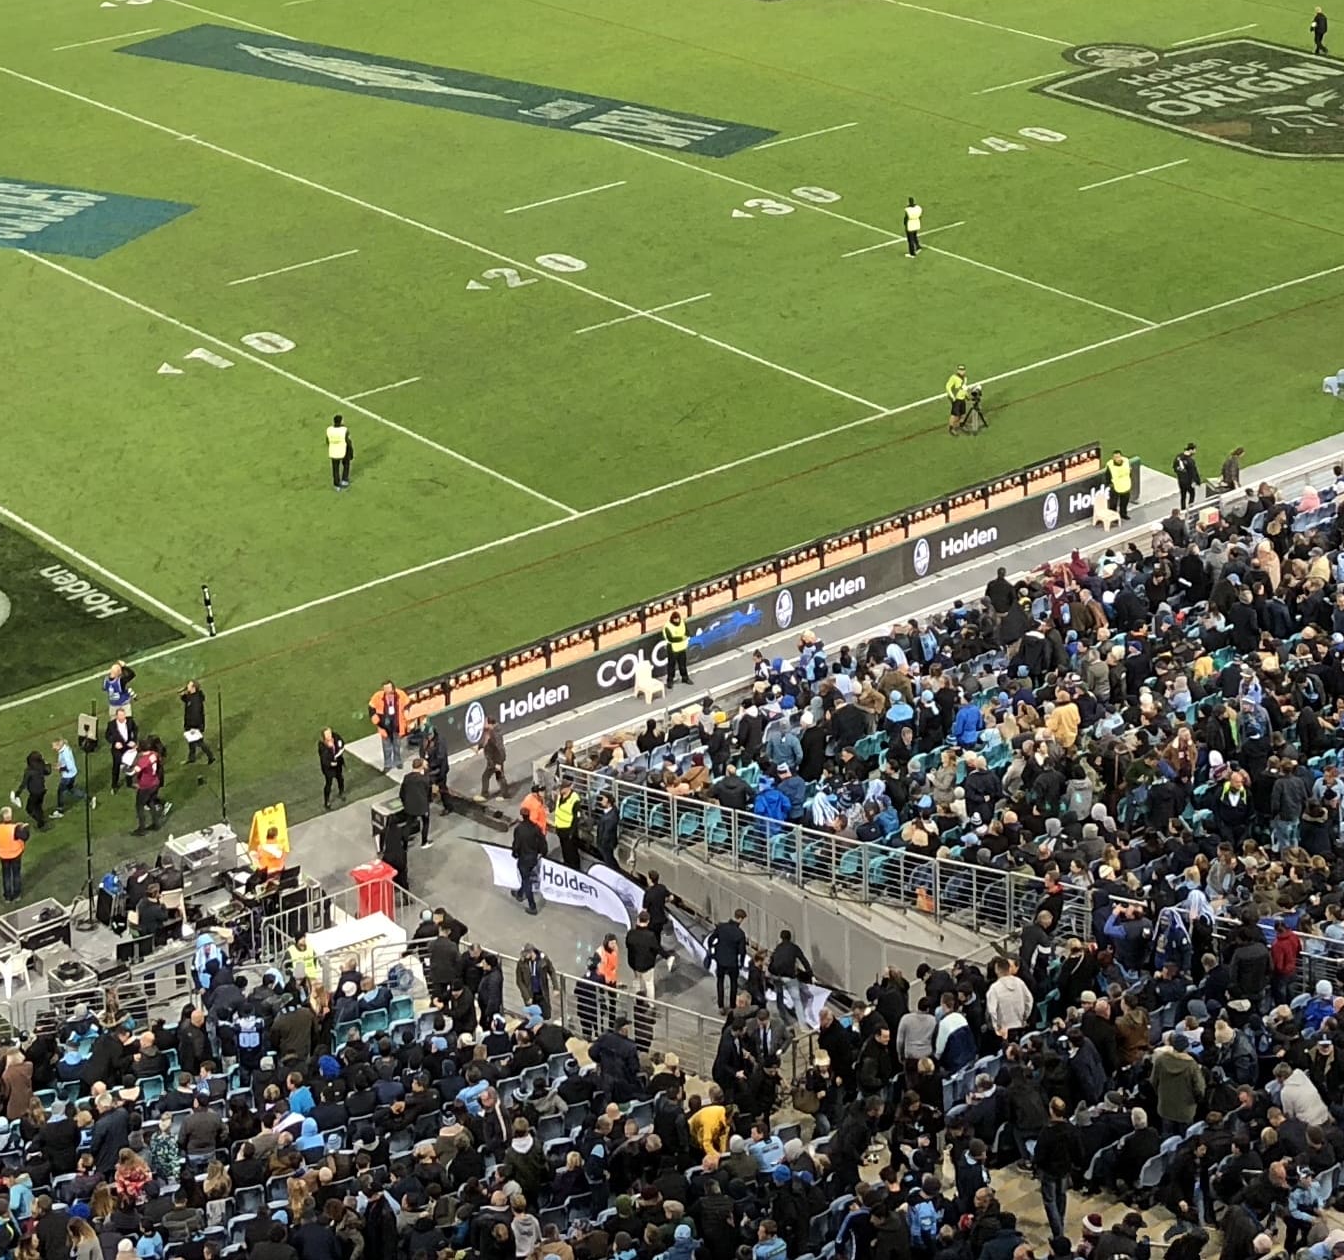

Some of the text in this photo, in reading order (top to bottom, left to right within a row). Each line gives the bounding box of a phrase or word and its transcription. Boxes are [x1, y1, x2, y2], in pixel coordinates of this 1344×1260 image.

[1118, 57, 1231, 87] Holden
[1136, 60, 1270, 100] STATE OF
[570, 106, 728, 148] DRY
[984, 126, 1067, 155] 40
[744, 186, 843, 216] 30
[482, 252, 588, 288] 20
[184, 331, 296, 368] 10
[940, 524, 998, 560] Holden
[38, 562, 130, 620] Holden
[805, 575, 866, 611] Holden
[498, 684, 570, 724] Holden
[542, 864, 600, 901] Holden
